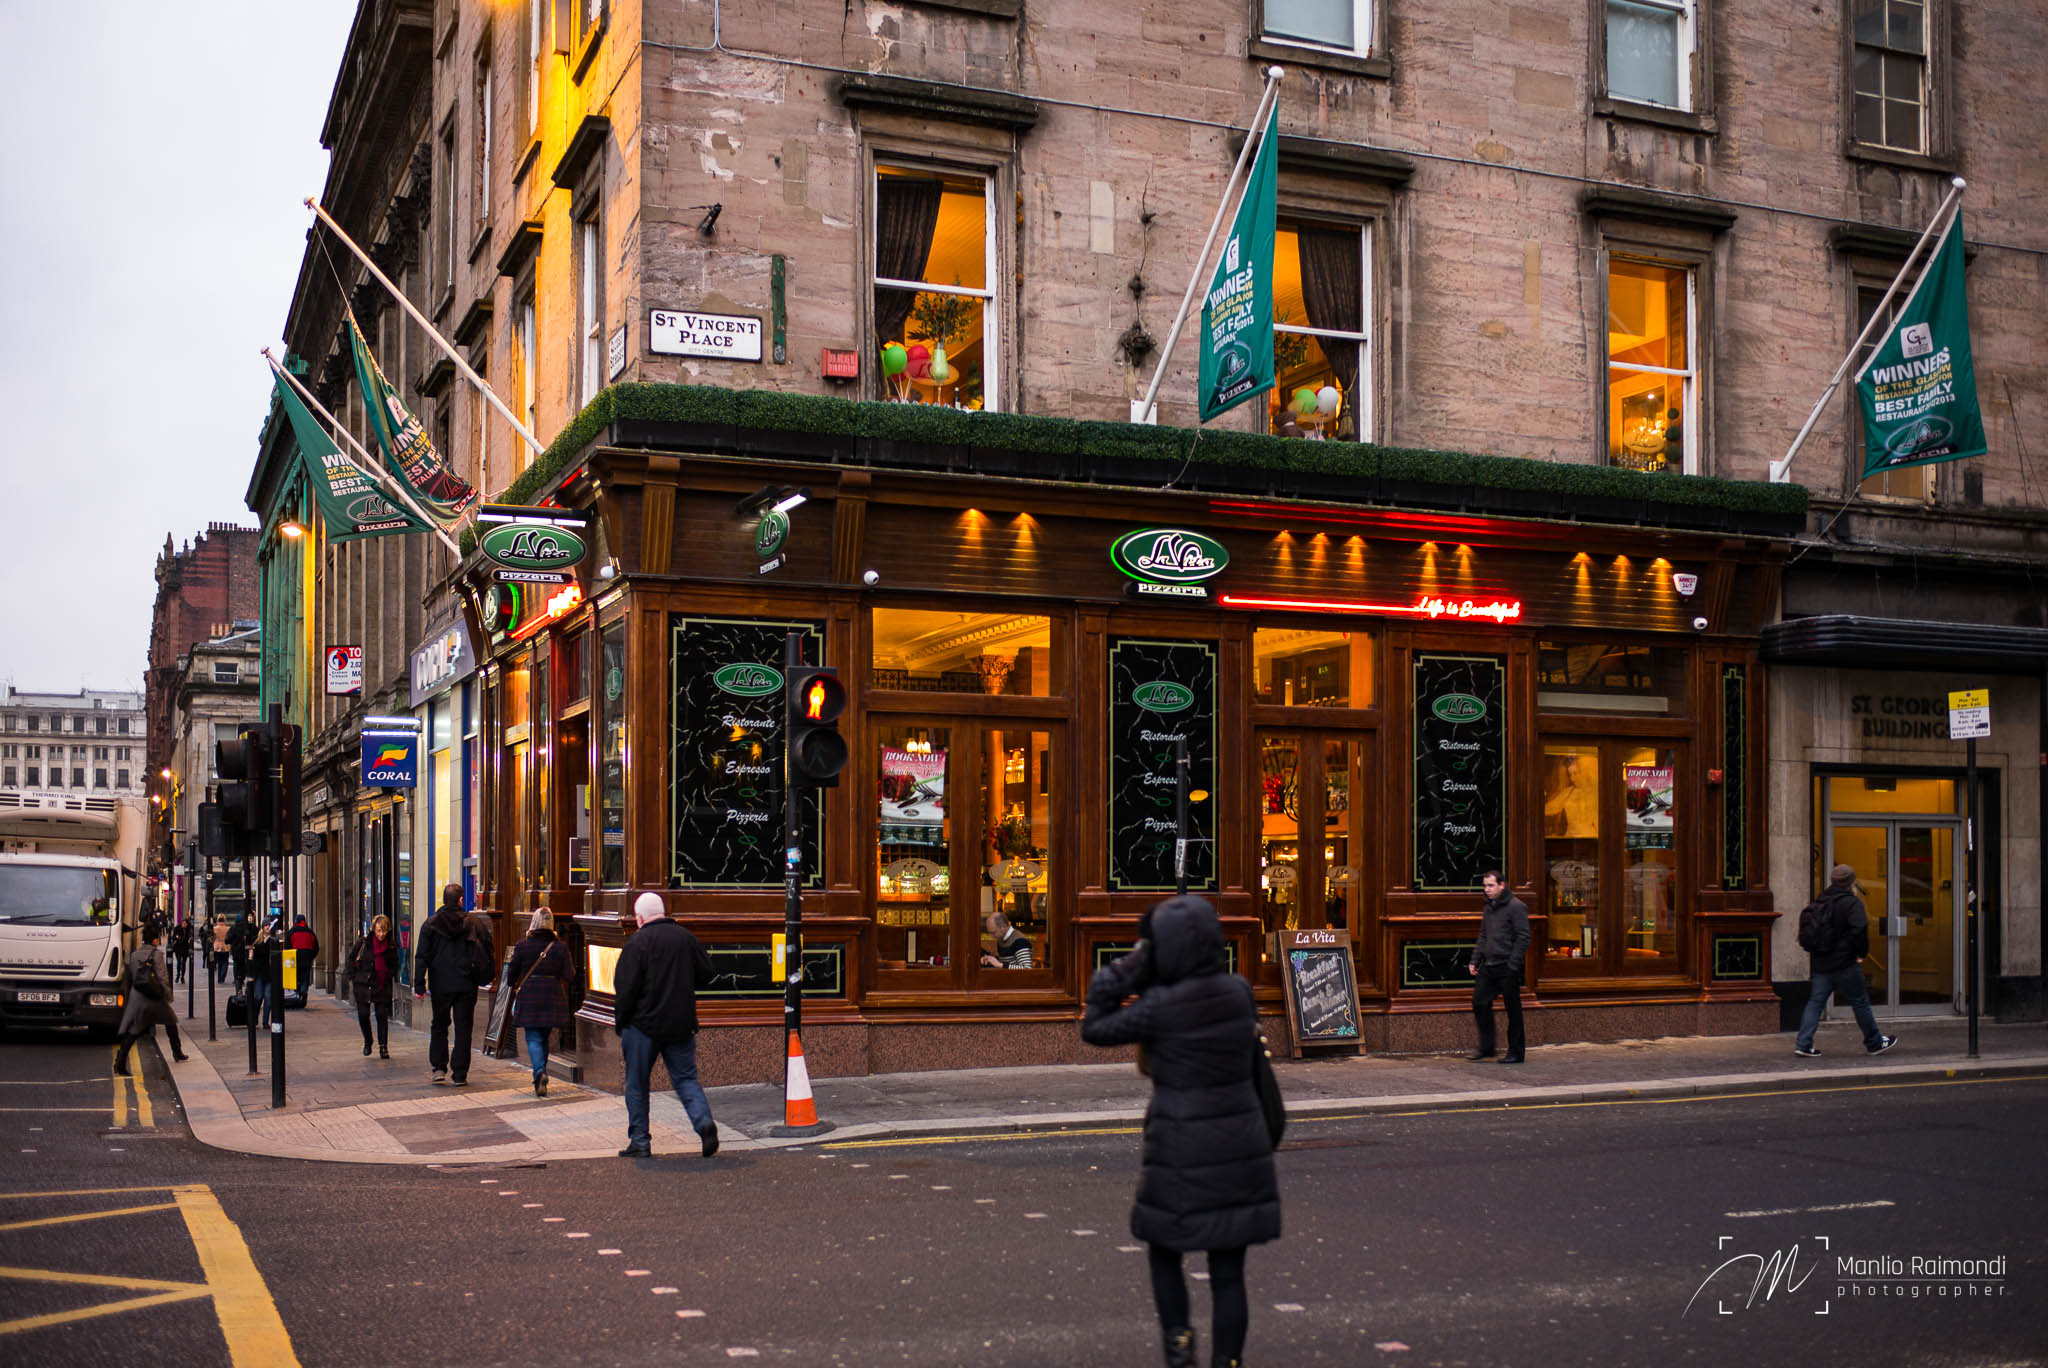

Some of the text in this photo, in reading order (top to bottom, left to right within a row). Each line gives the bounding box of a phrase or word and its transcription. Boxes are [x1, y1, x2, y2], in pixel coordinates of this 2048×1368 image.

[1875, 385, 1888, 394] OF
[1891, 380, 1912, 390] THE
[1875, 396, 1914, 413] BEST
[330, 477, 363, 490] BEST
[359, 521, 408, 532] Pizzeria
[1138, 532, 1215, 572] La Vita
[1420, 596, 1520, 622] Life is Beautiful
[349, 648, 361, 658] TO
[722, 714, 776, 728] Ristorante
[1140, 730, 1186, 742] Ristorante
[1439, 739, 1480, 750] Ristorante
[885, 752, 941, 762] BOOK NOW
[368, 771, 412, 781] CORAL
[725, 761, 771, 777] Espresso
[1442, 779, 1478, 792] Espresso
[726, 809, 768, 825] Pizzeria
[1443, 822, 1476, 836] Pizzeria
[1296, 930, 1336, 944] La Vita
